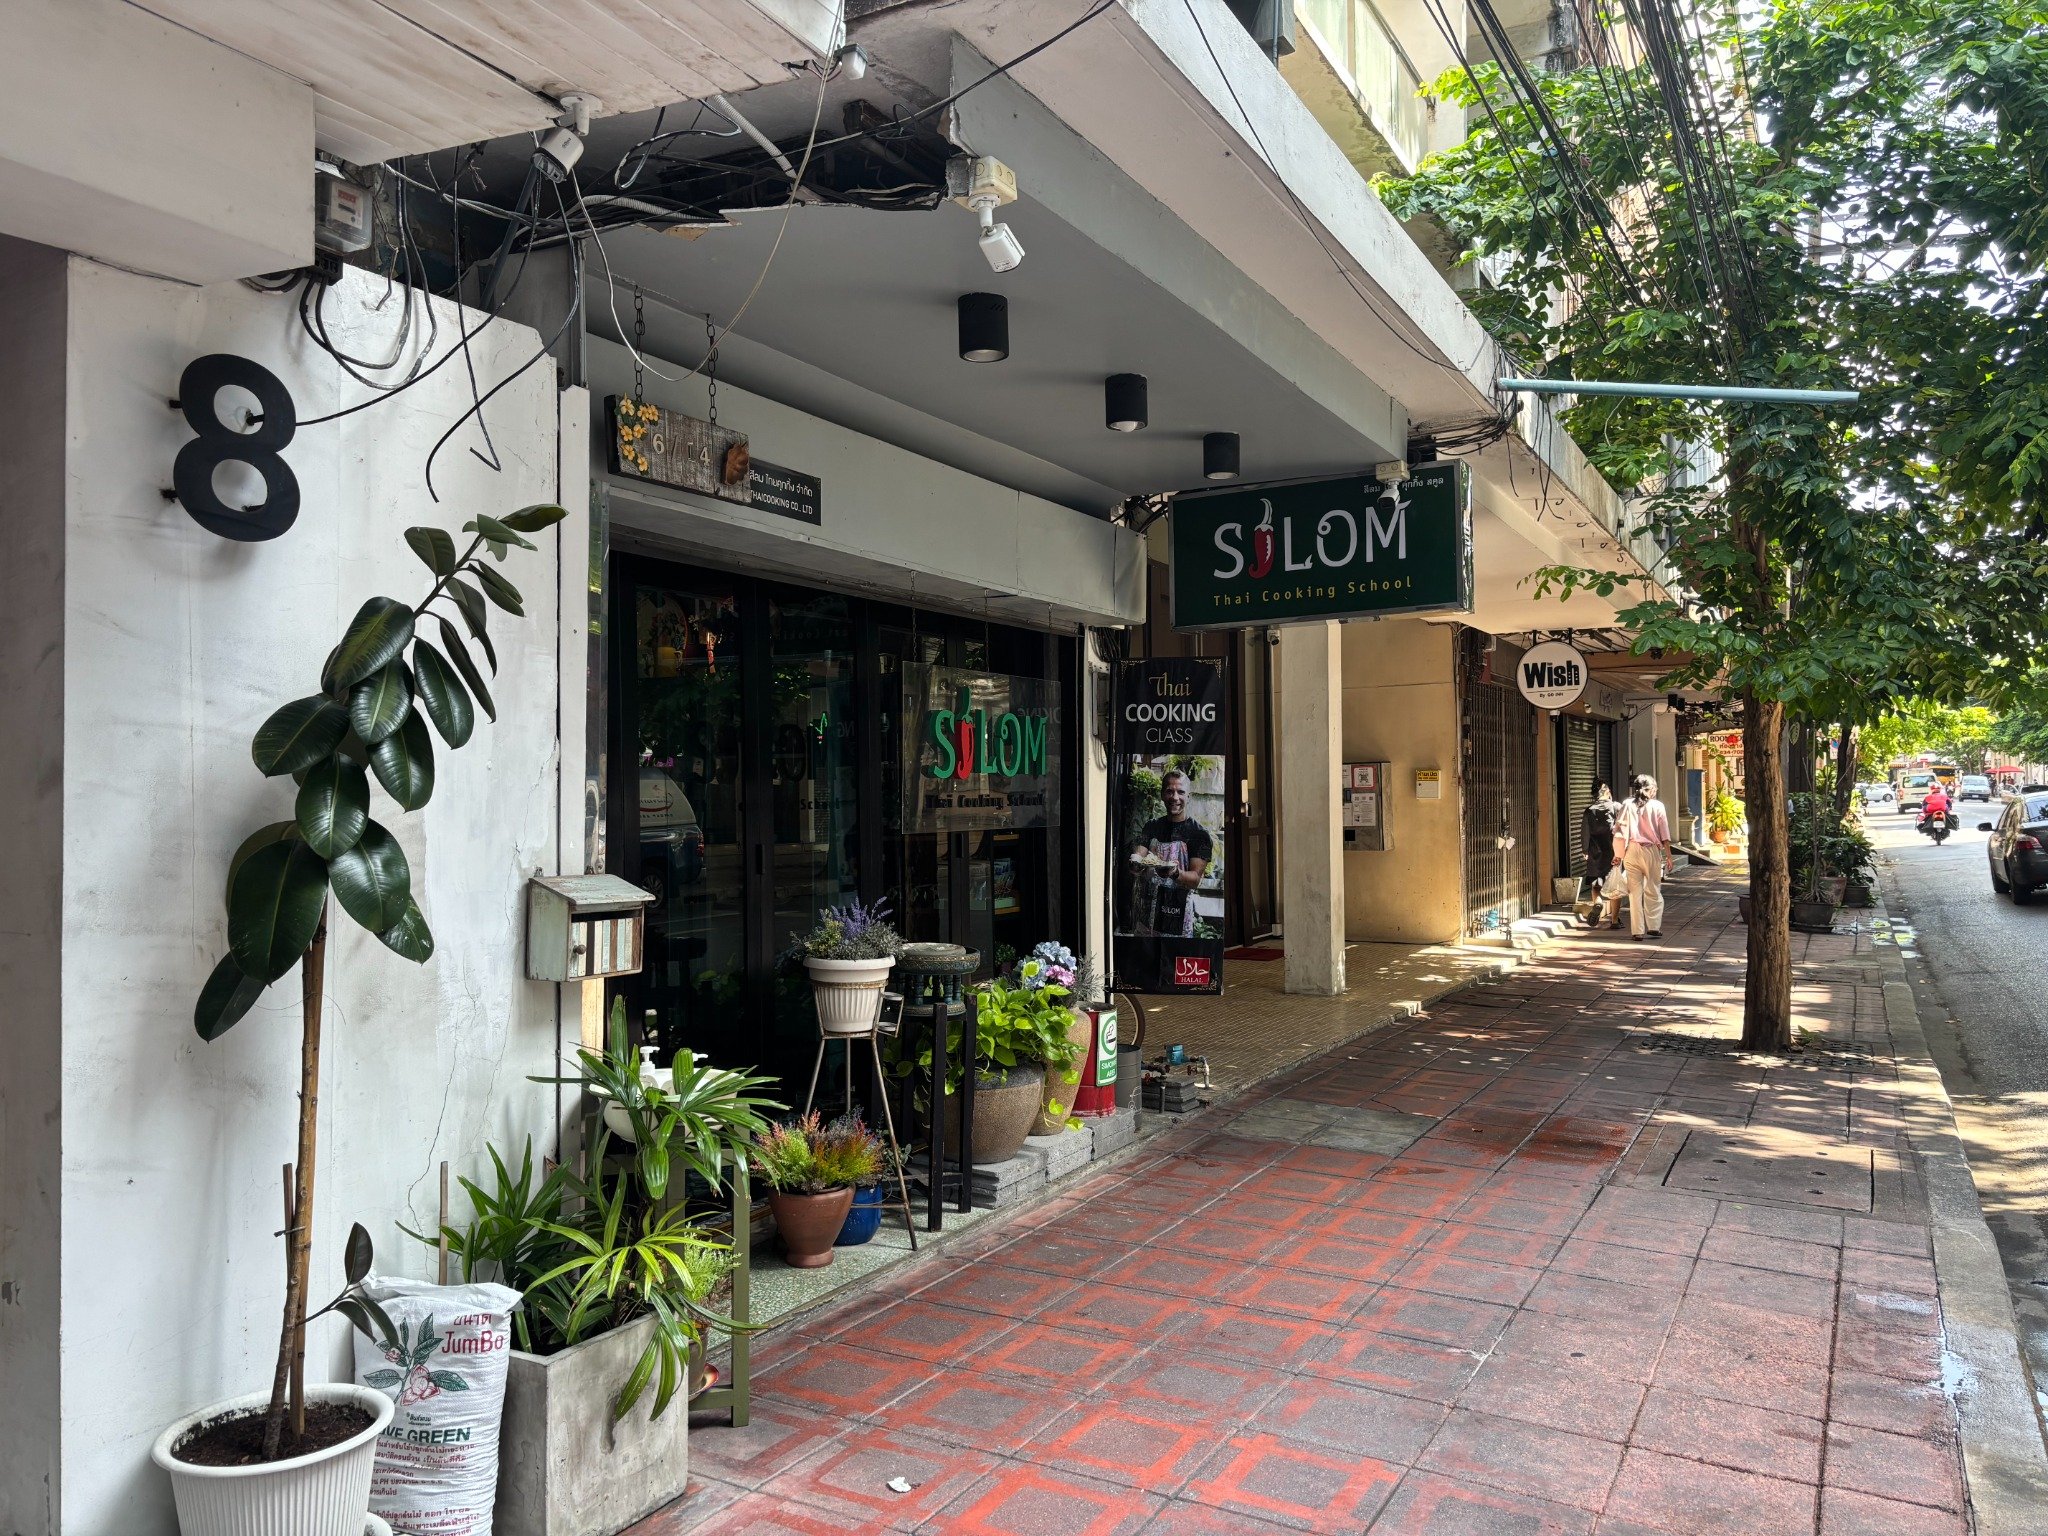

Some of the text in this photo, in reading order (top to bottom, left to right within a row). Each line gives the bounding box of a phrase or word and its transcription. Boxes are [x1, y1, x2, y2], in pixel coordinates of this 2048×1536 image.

[173, 354, 299, 541] 8
[802, 504, 813, 515] LTD
[1213, 498, 1411, 579] SILOM
[1214, 575, 1411, 606] Thai Cooking School
[1148, 672, 1192, 696] Thai
[1523, 660, 1580, 688] Wish
[1125, 703, 1216, 722] COOKING
[932, 687, 1048, 779] SILOM
[1145, 727, 1193, 743] CLASS
[1176, 958, 1209, 976] حلال
[442, 1330, 504, 1354] JumBo
[407, 1426, 471, 1444] GREEN
